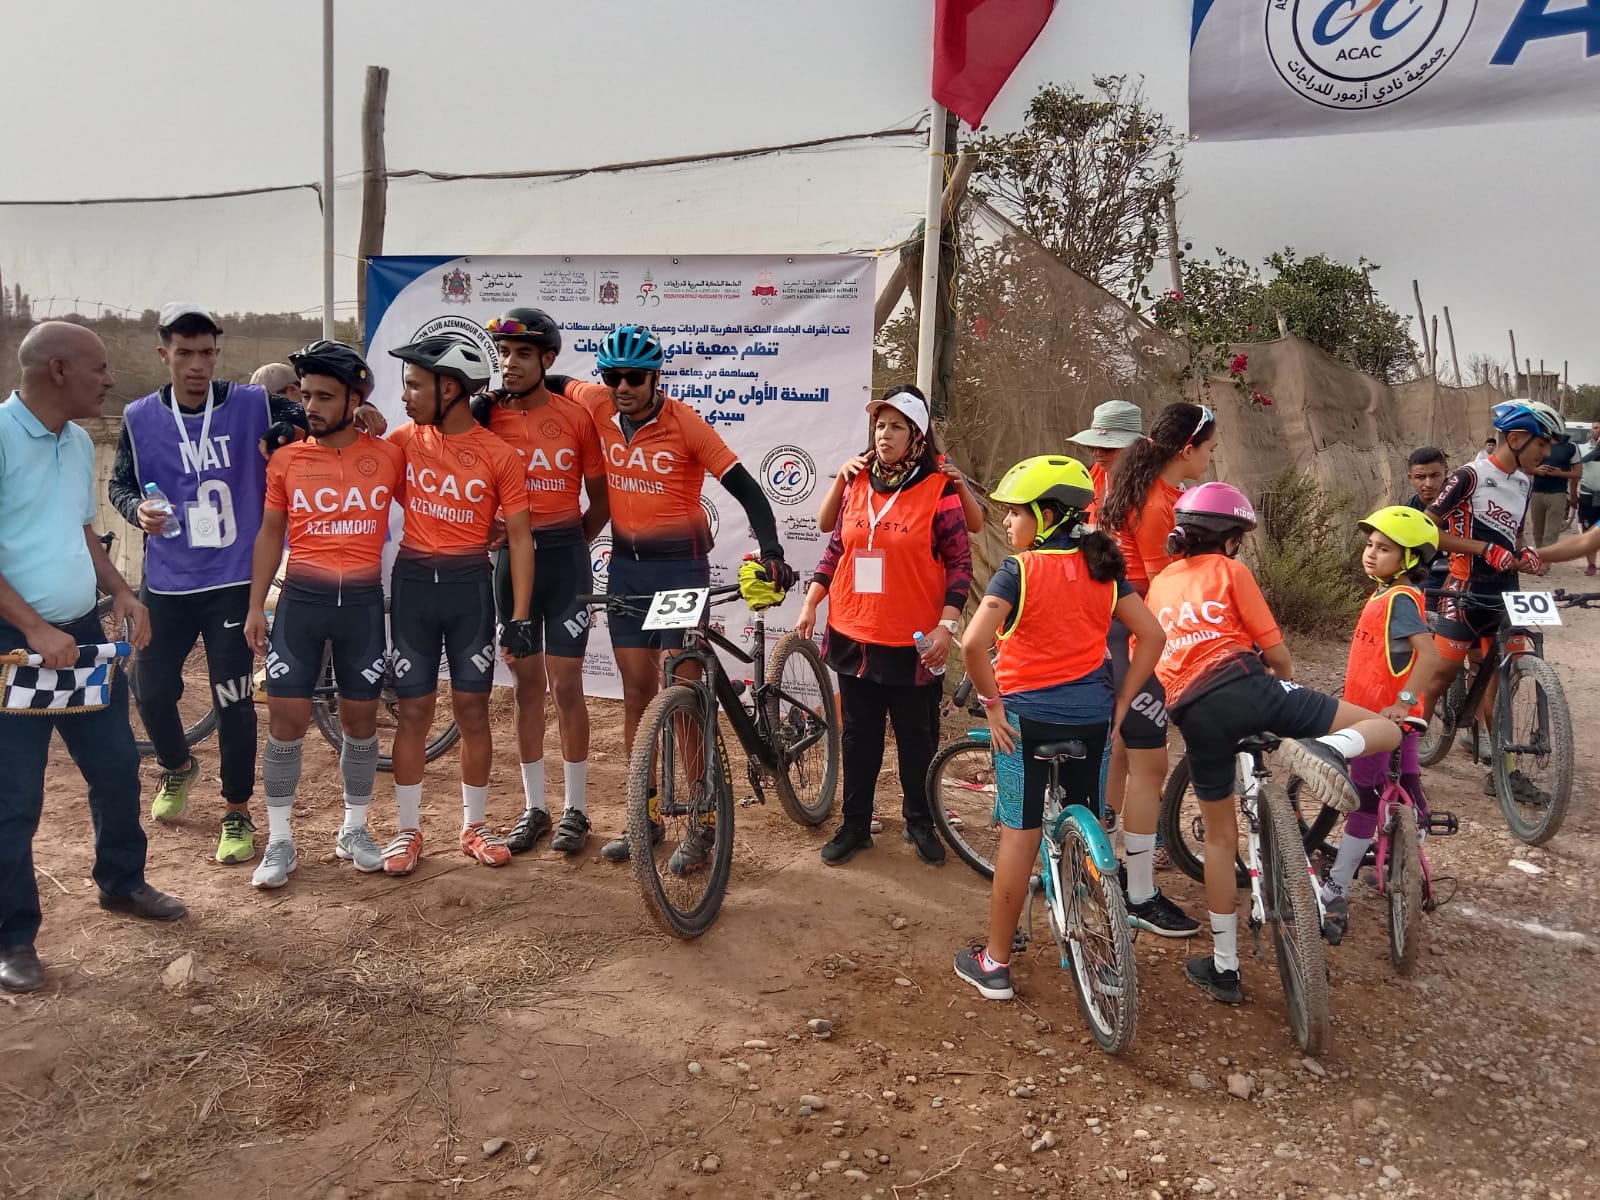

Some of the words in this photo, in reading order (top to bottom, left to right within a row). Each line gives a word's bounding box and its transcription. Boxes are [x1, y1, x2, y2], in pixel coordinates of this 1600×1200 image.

[1335, 45, 1382, 62] ACAC
[1405, 47, 1447, 81] جمعية
[1287, 59, 1335, 96] للدراجات
[1333, 82, 1369, 103] أزمور
[1372, 78, 1404, 103] نادي
[565, 322, 590, 330] سطات
[651, 324, 676, 336] وعصبة
[677, 324, 709, 336] للدراجات
[710, 325, 742, 336] المغربية
[744, 325, 771, 336] الملكية
[772, 325, 801, 334] الجامعة
[802, 325, 830, 337] إشراف
[831, 325, 851, 335] تحت
[427, 322, 443, 333] CLUB
[443, 319, 479, 336] AZEMMOUR
[477, 332, 486, 342] DE
[483, 340, 500, 374] CYCLISME
[664, 341, 693, 363] نادي
[696, 341, 739, 360] جمعية
[741, 341, 779, 360] تنظم
[660, 368, 678, 379] سيد
[679, 367, 703, 380] جماعة
[704, 368, 717, 379] من
[718, 368, 759, 381] بمساهمة
[670, 383, 713, 403] الجائزة
[714, 387, 736, 404] من
[739, 381, 778, 406] الأولى
[780, 386, 829, 403] النسخة
[515, 448, 575, 471] AC
[406, 462, 487, 503] ACAC
[292, 485, 390, 513] ACAC
[410, 496, 474, 524] AZEMMOUR
[305, 519, 377, 535] AZEMMOUR
[657, 591, 699, 615] 53
[1512, 594, 1549, 615] 50
[1158, 600, 1228, 630] CAC
[1131, 692, 1168, 728] CAC
